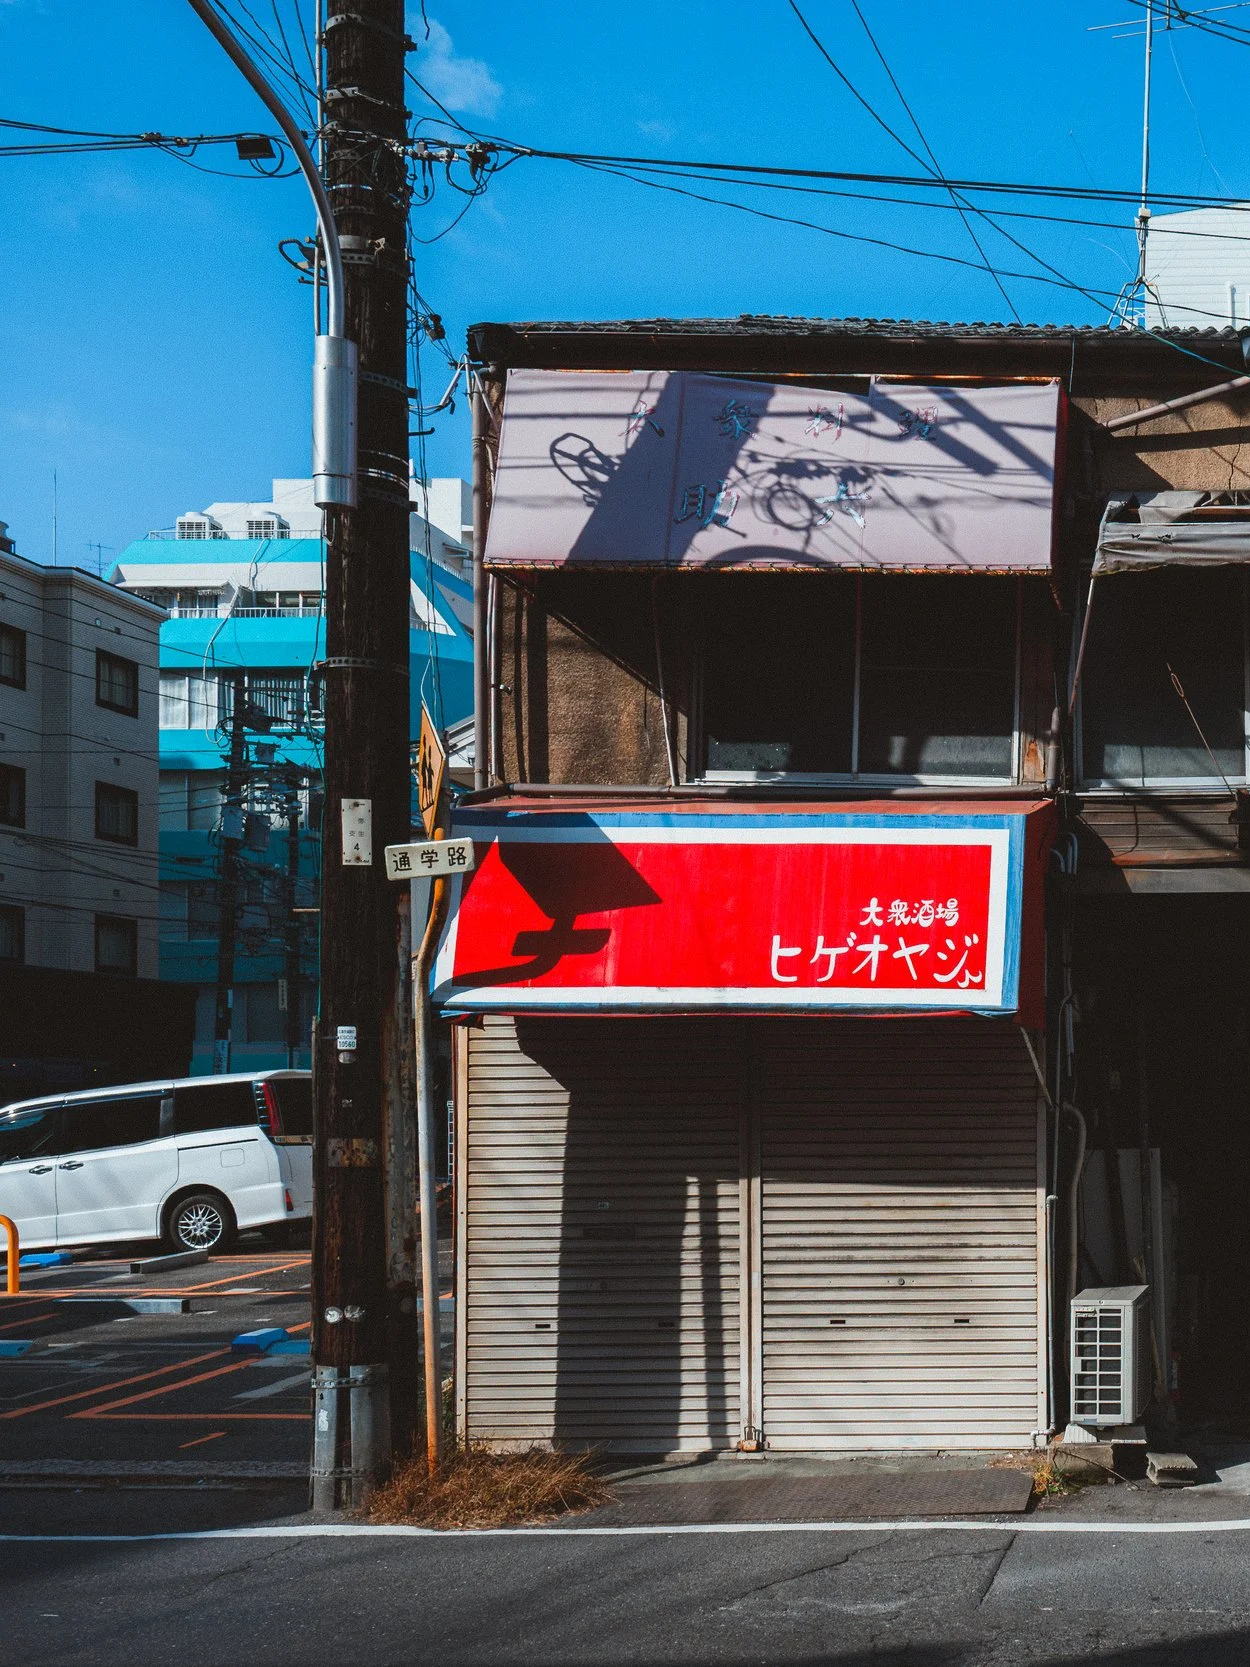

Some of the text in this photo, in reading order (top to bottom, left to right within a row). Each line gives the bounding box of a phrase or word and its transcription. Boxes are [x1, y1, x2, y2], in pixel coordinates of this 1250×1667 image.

[392, 846, 468, 873] 通学路
[859, 896, 960, 928] 大衆酒場
[770, 931, 982, 986] ヒゲオヤジ
